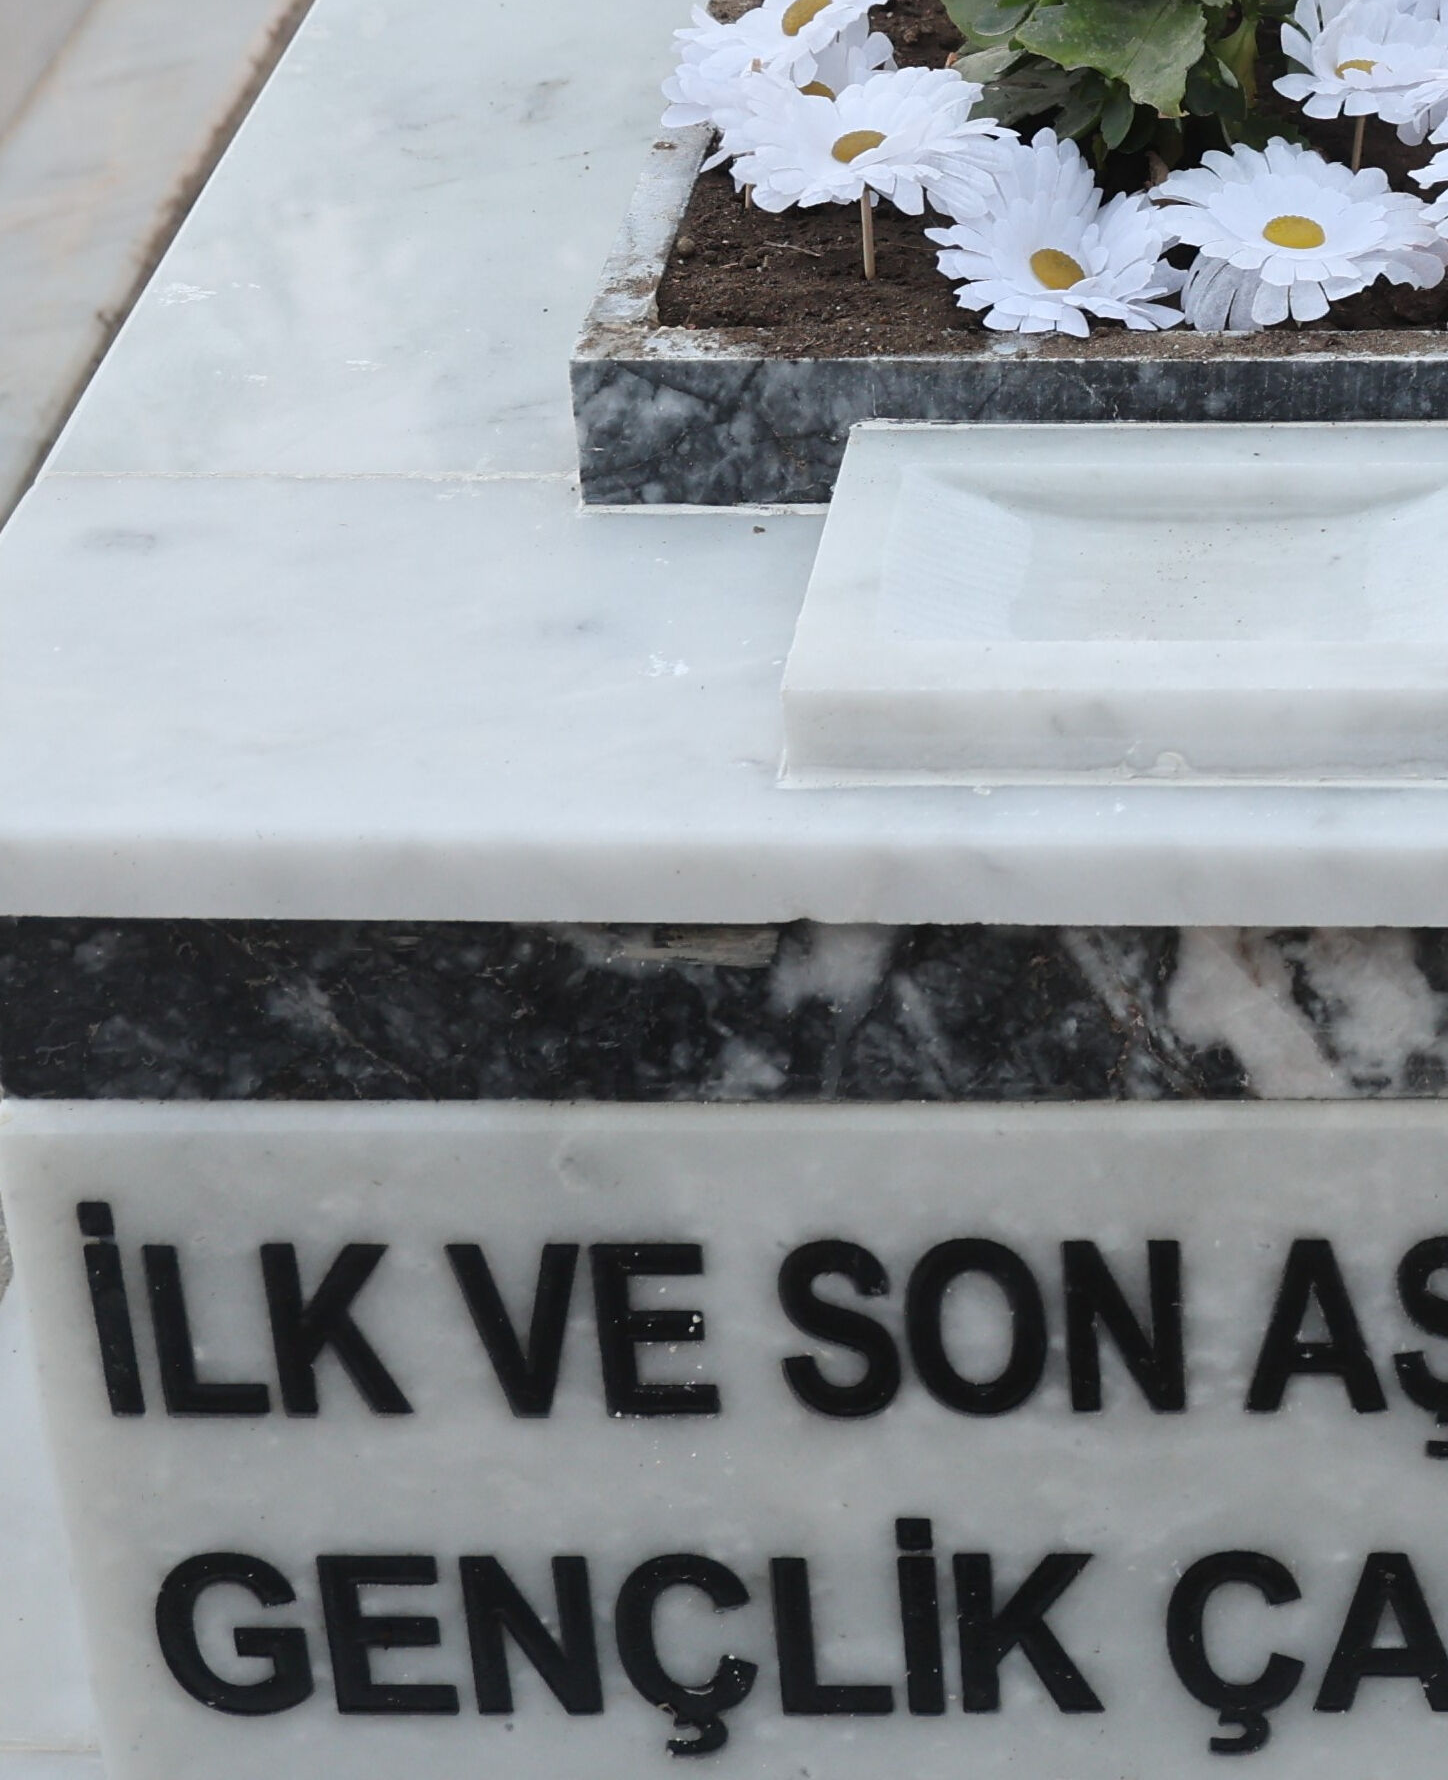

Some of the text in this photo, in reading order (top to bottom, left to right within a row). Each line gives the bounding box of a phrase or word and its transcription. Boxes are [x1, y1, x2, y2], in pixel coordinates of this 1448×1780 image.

[76, 1200, 416, 1418] İLK
[443, 1241, 723, 1419] VE
[777, 1236, 1188, 1418] SON
[155, 1516, 1106, 1757] GENÇLİK
